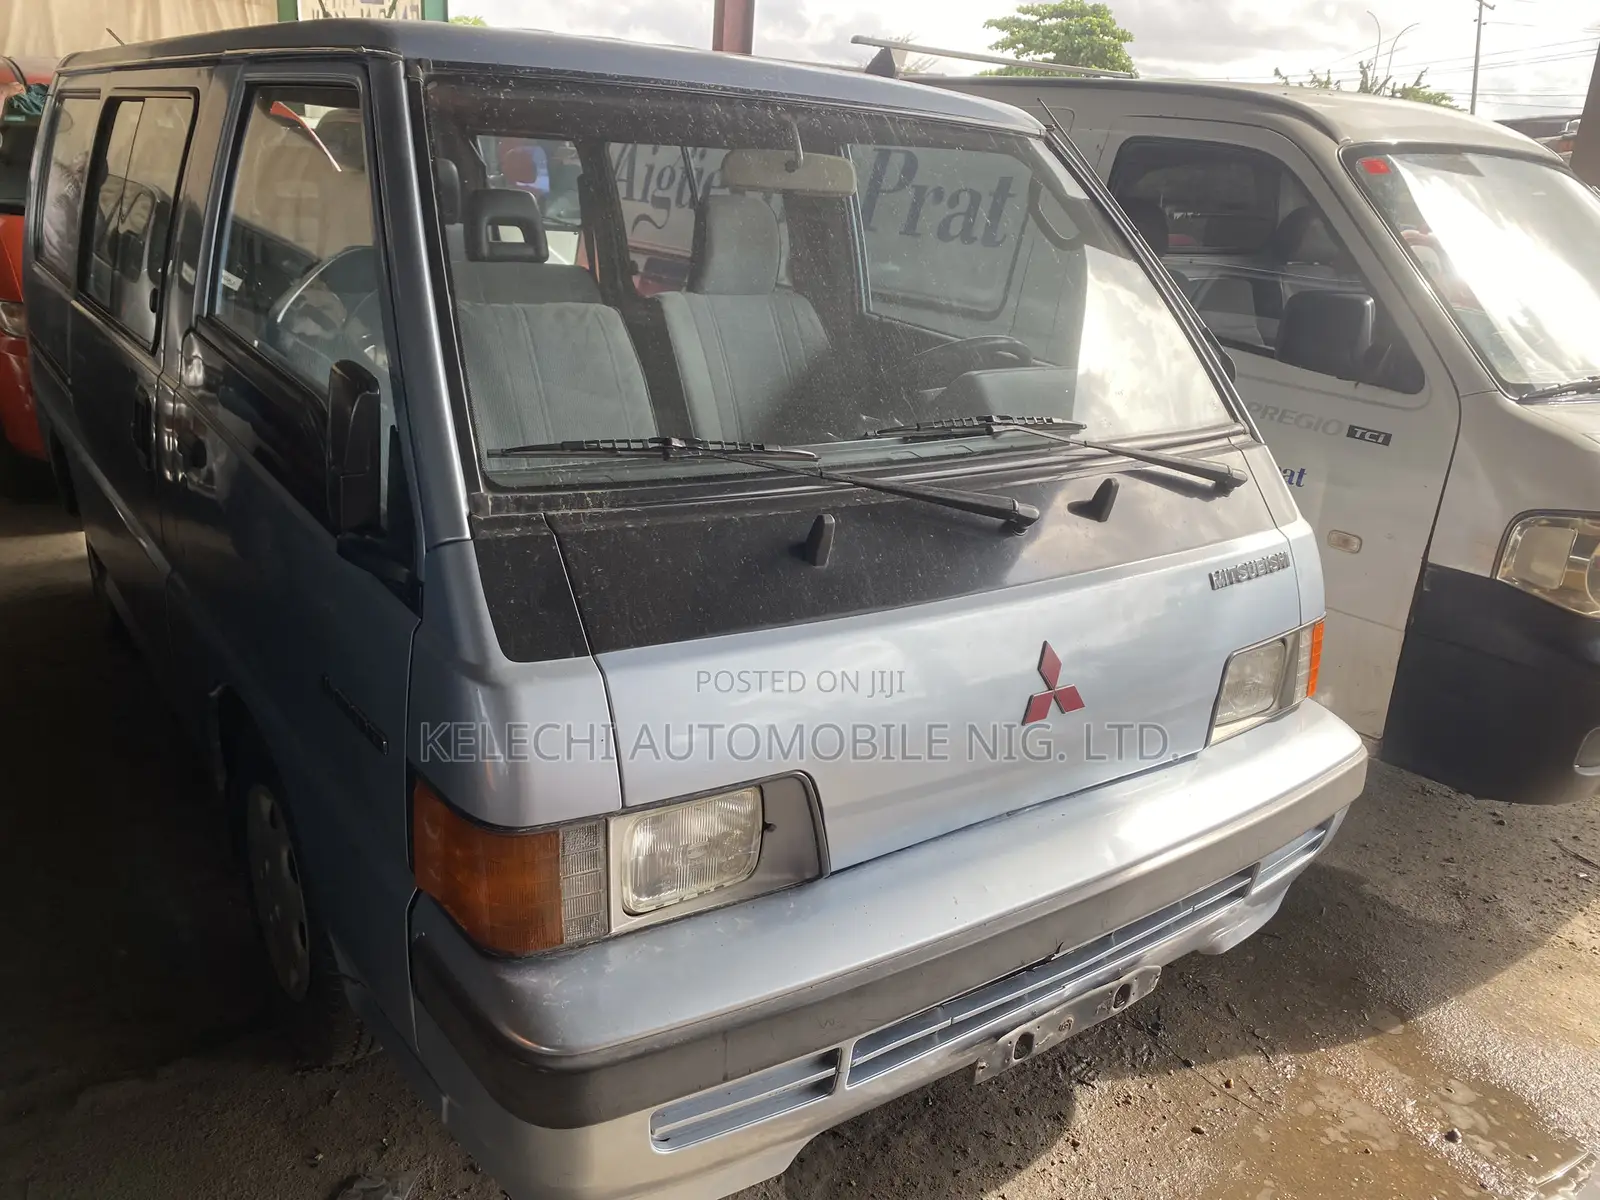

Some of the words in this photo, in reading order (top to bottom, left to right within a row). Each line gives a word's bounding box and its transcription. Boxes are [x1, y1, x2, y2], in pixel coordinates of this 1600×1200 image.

[861, 148, 1017, 248] Prat
[1245, 401, 1344, 436] PREGIO
[1278, 466, 1307, 488] at
[1209, 551, 1290, 590] MITSUBISHI
